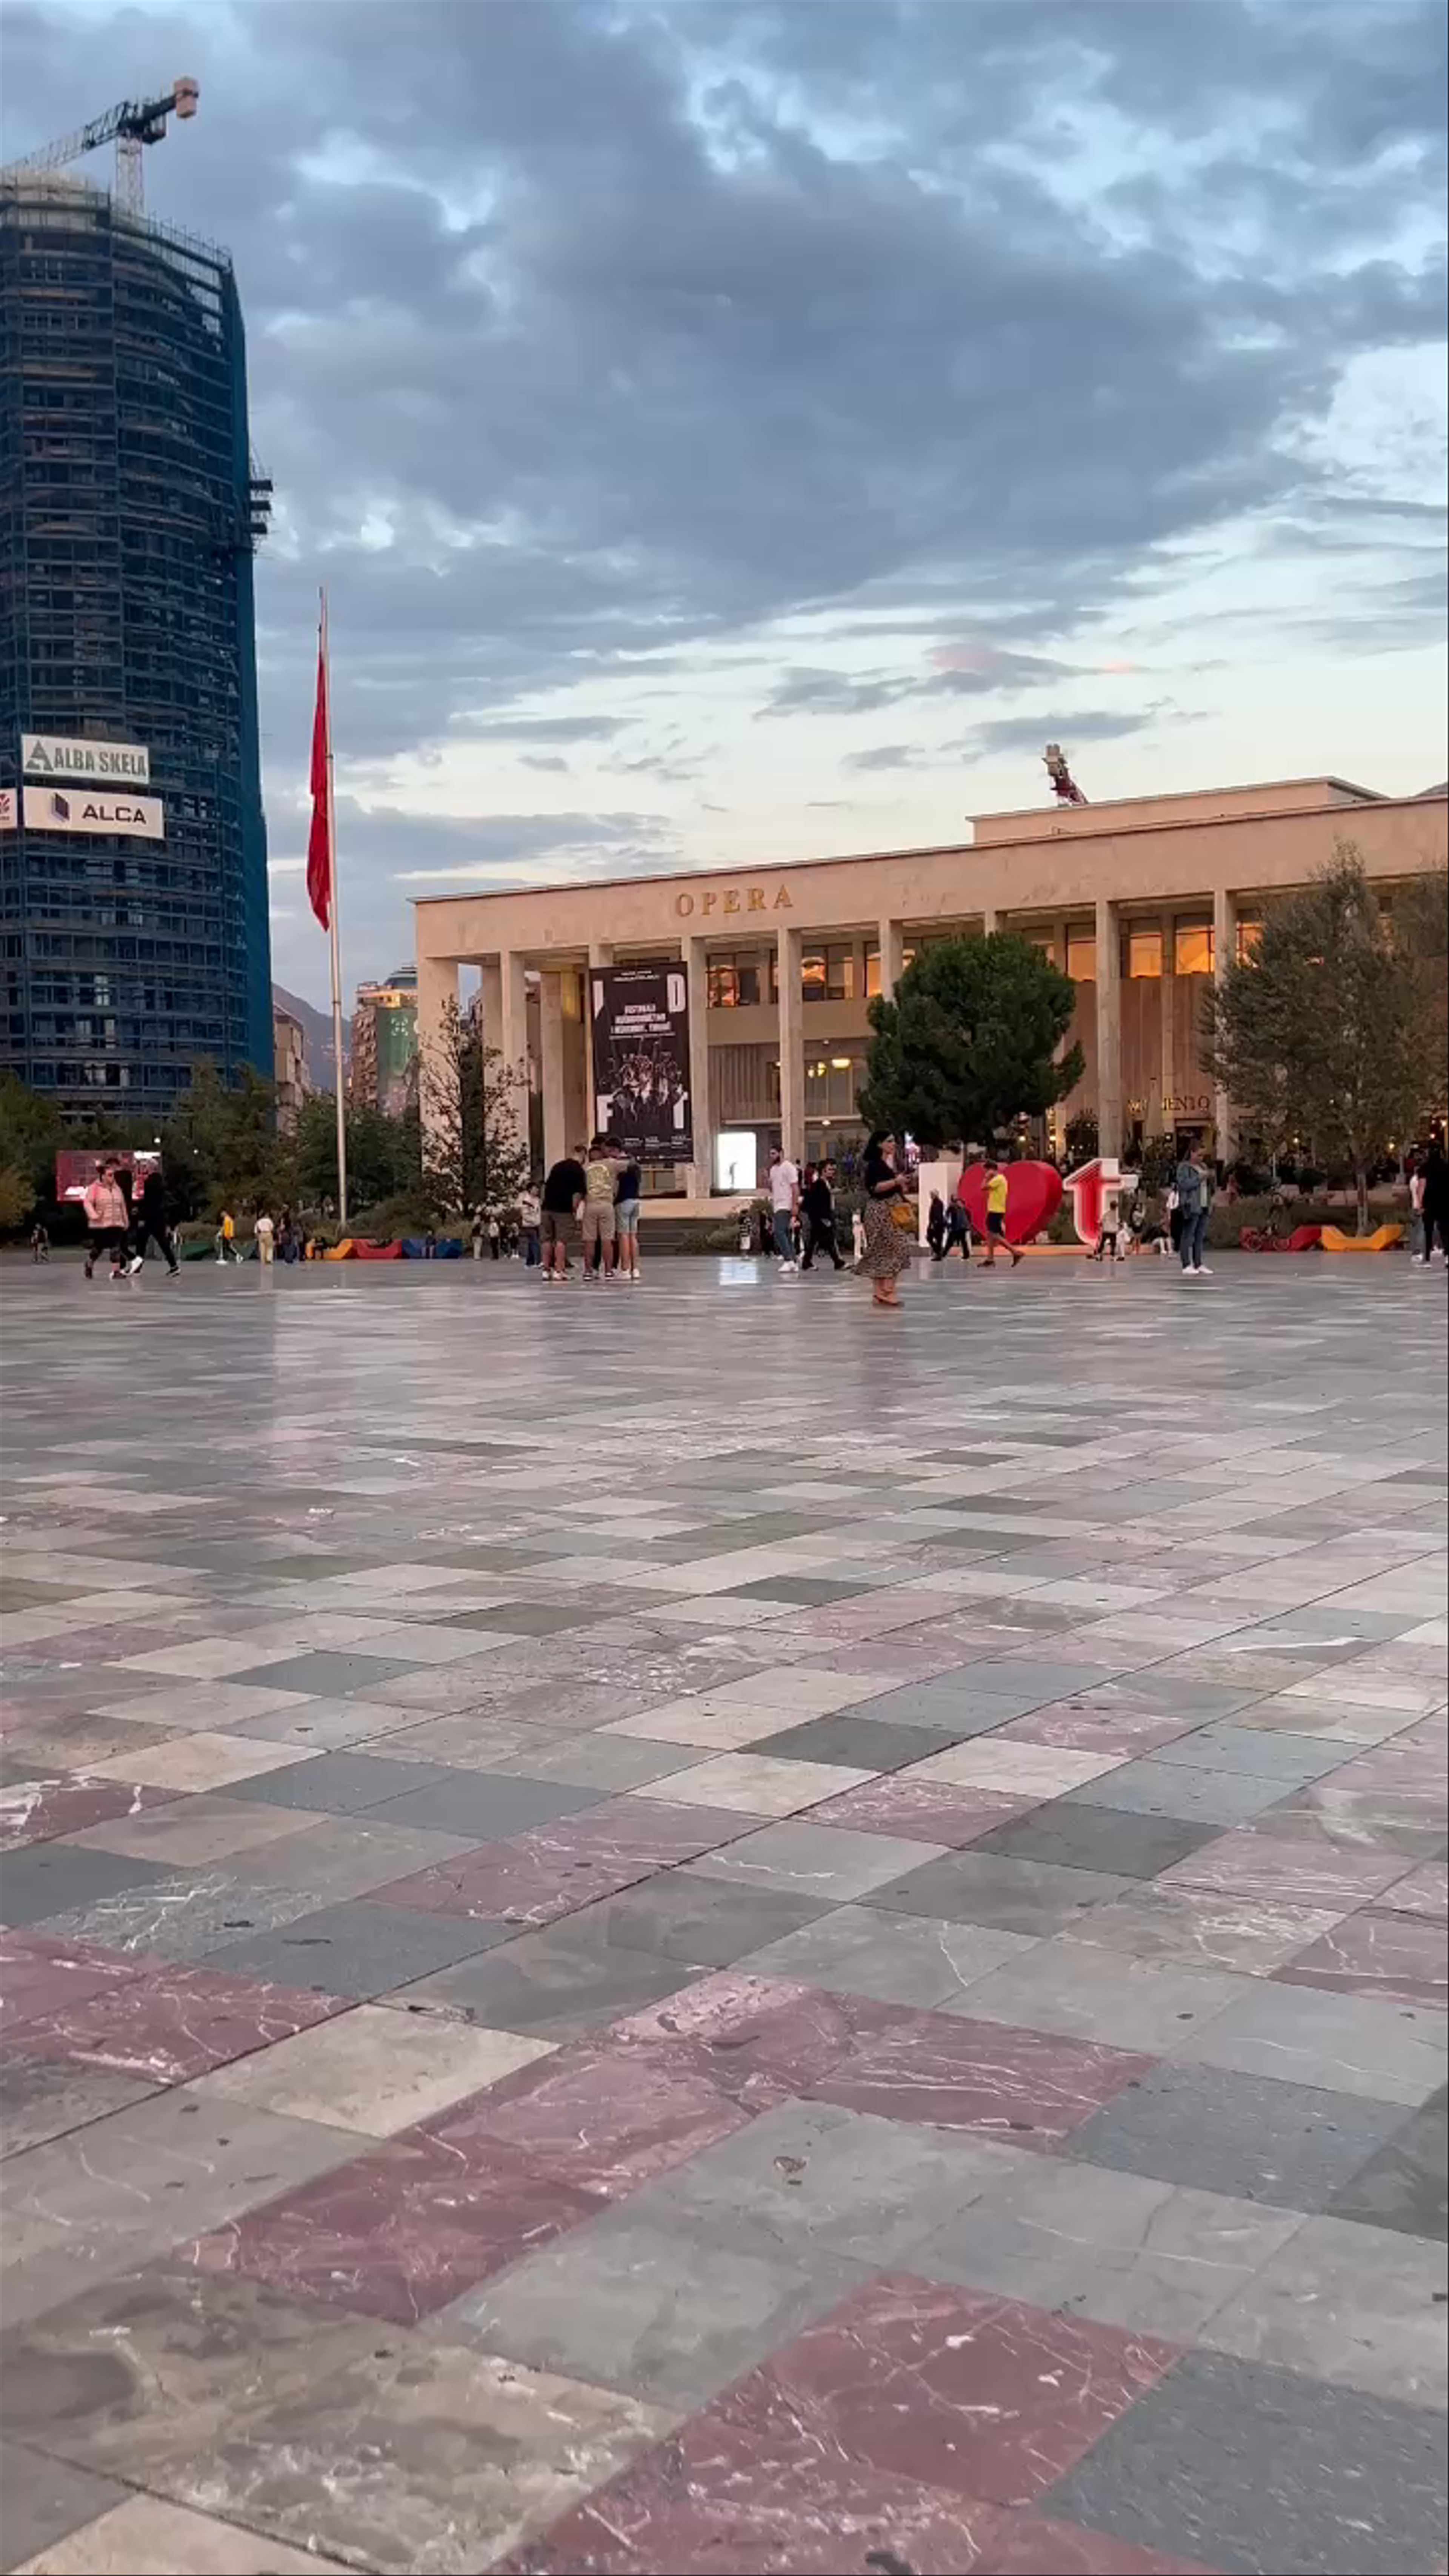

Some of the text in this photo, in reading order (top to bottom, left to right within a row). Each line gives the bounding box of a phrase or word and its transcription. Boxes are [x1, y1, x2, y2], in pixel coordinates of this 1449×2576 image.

[54, 747, 94, 772] ALBA
[99, 752, 146, 776] SKELA
[82, 804, 146, 824] ALCA
[675, 884, 793, 917] OPERA
[667, 973, 686, 1013] D
